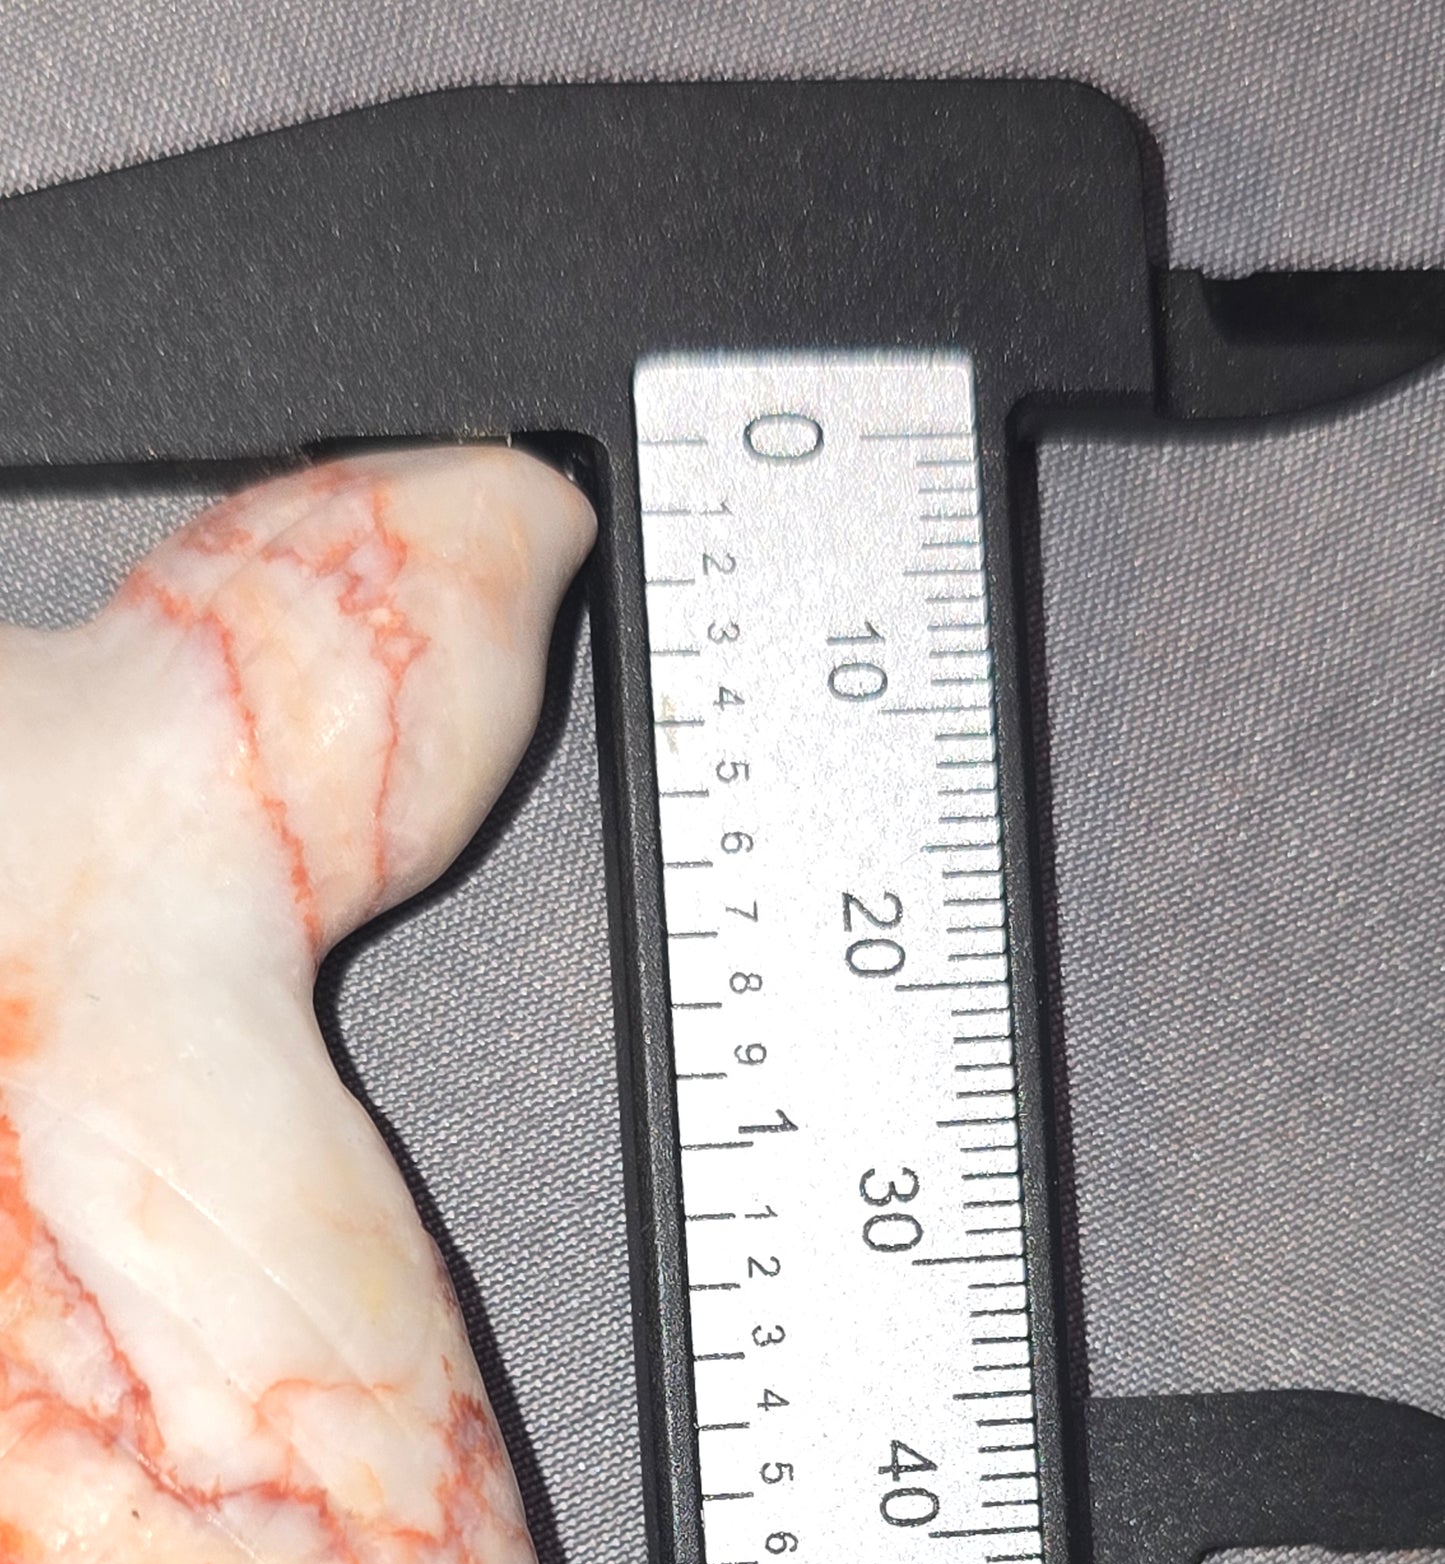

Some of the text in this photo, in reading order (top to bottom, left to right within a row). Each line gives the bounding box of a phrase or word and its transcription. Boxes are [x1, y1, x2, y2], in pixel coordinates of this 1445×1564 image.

[742, 412, 825, 460] 0
[700, 501, 734, 517] 1
[702, 552, 738, 576] 2
[707, 620, 741, 645] 3
[826, 621, 888, 702] 10
[713, 685, 745, 710] 4
[715, 760, 750, 783] 5
[720, 831, 754, 855] 6
[725, 900, 759, 922] 7
[842, 891, 906, 978] 20
[729, 971, 763, 994] 8
[733, 1043, 767, 1066] 9
[738, 1108, 799, 1134] 1
[744, 1204, 779, 1220] 1
[859, 1167, 924, 1253] 30
[747, 1255, 781, 1279] 2
[751, 1324, 786, 1348] 3
[757, 1388, 790, 1412] 4
[759, 1461, 794, 1485] 5
[878, 1440, 940, 1528] 40
[764, 1531, 799, 1555] 6
